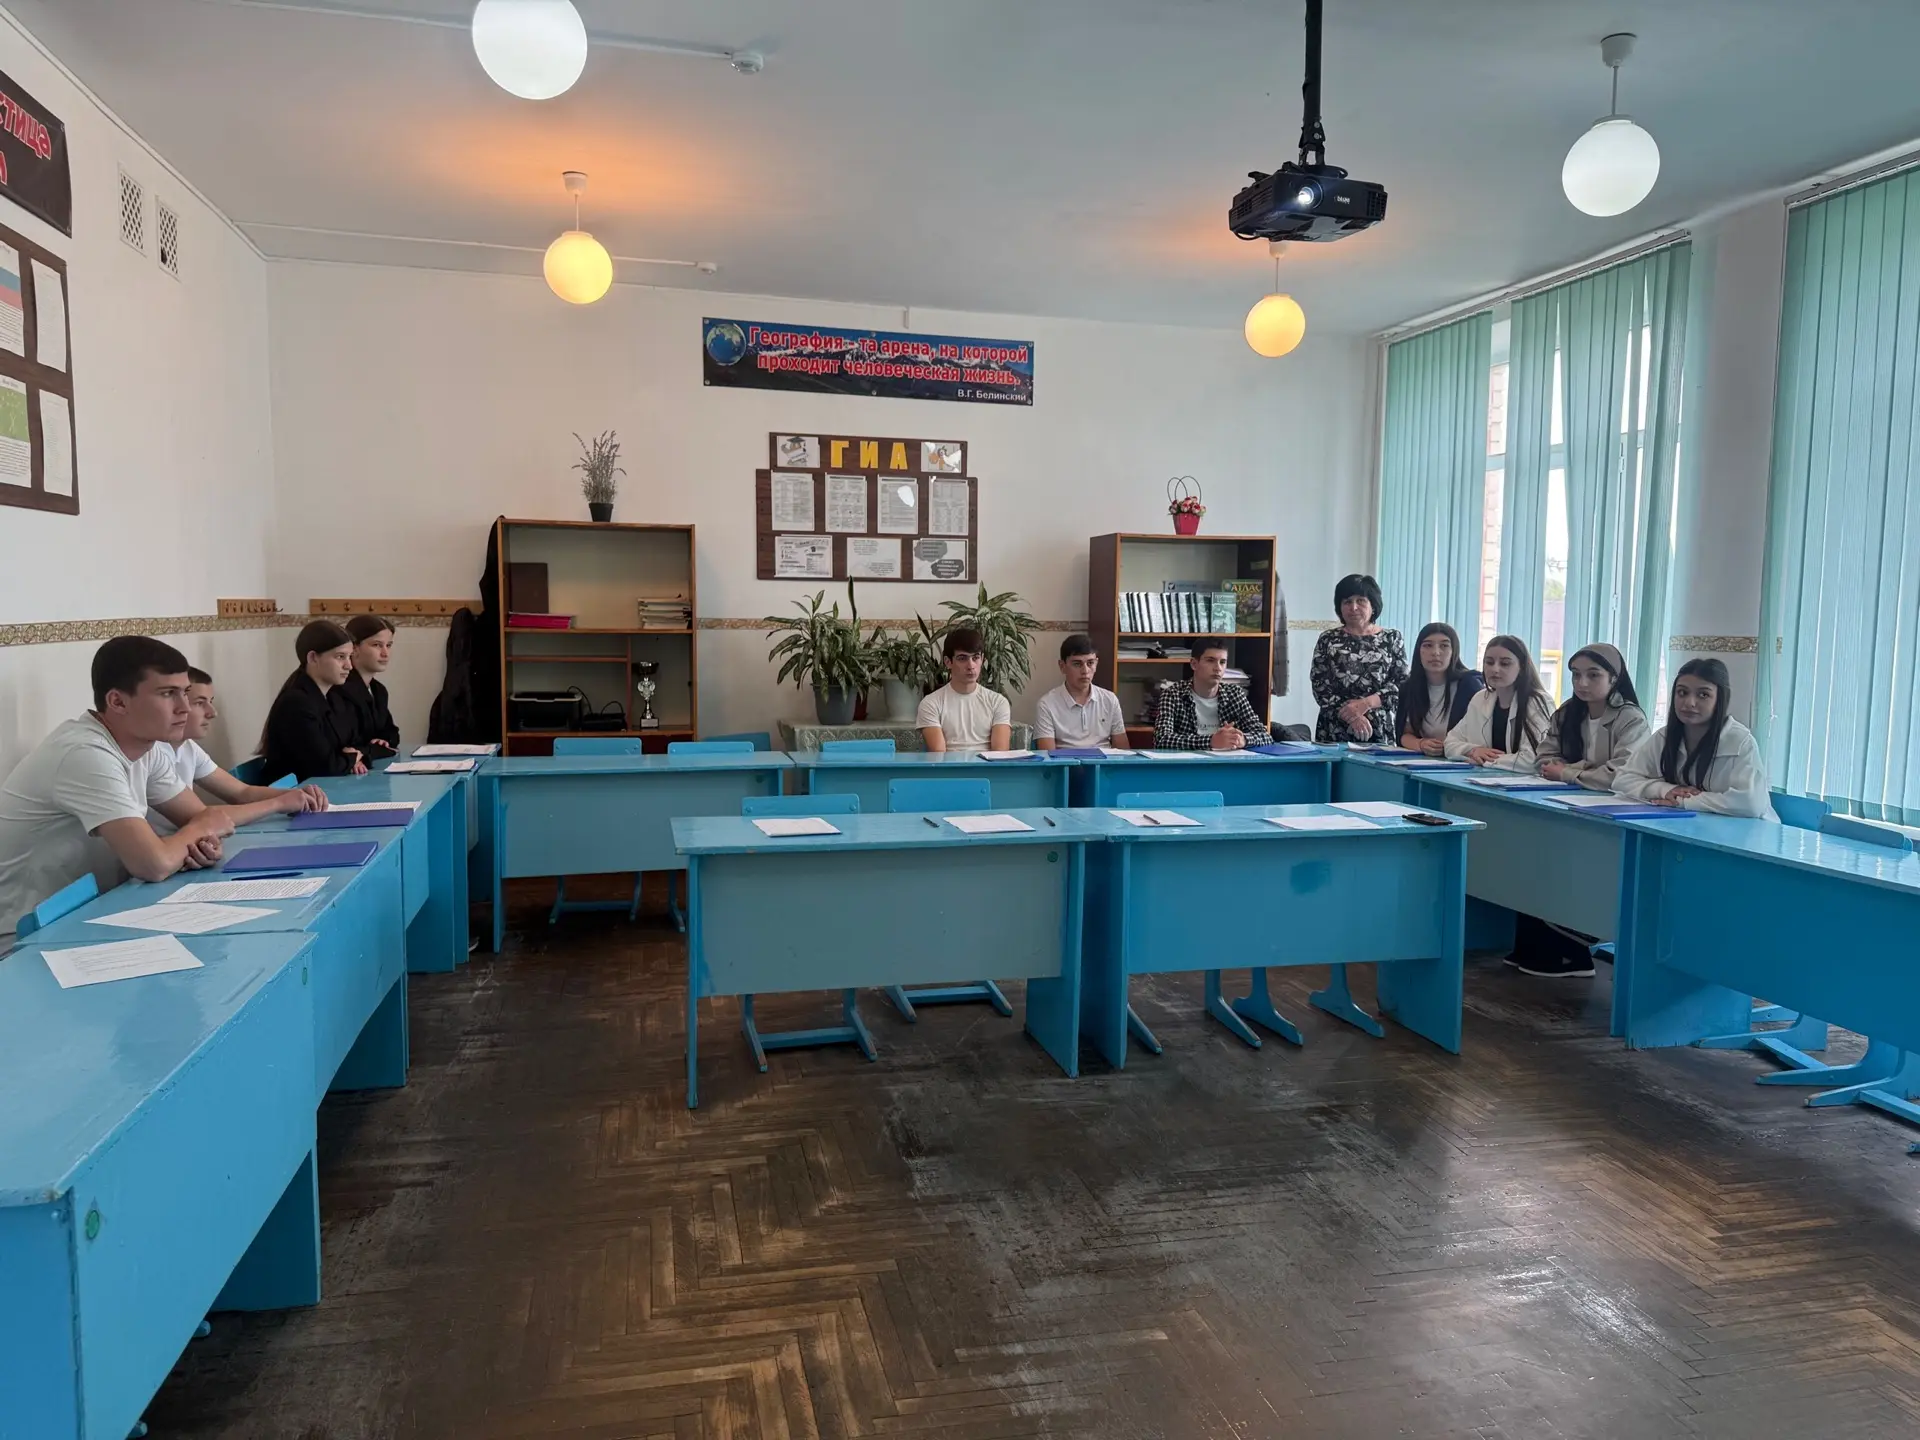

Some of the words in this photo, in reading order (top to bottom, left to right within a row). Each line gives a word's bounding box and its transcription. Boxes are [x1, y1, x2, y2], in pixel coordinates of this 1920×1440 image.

[749, 326, 843, 351] География
[859, 338, 878, 354] та
[881, 340, 936, 359] арена,
[938, 343, 959, 359] на
[962, 344, 1029, 365] которой
[758, 354, 840, 374] проходит
[843, 360, 960, 381] человеческая
[963, 368, 1021, 384] жизнь.
[957, 389, 974, 399] В.Г.
[976, 390, 1027, 401] Белинский
[830, 440, 908, 470] ГИА
